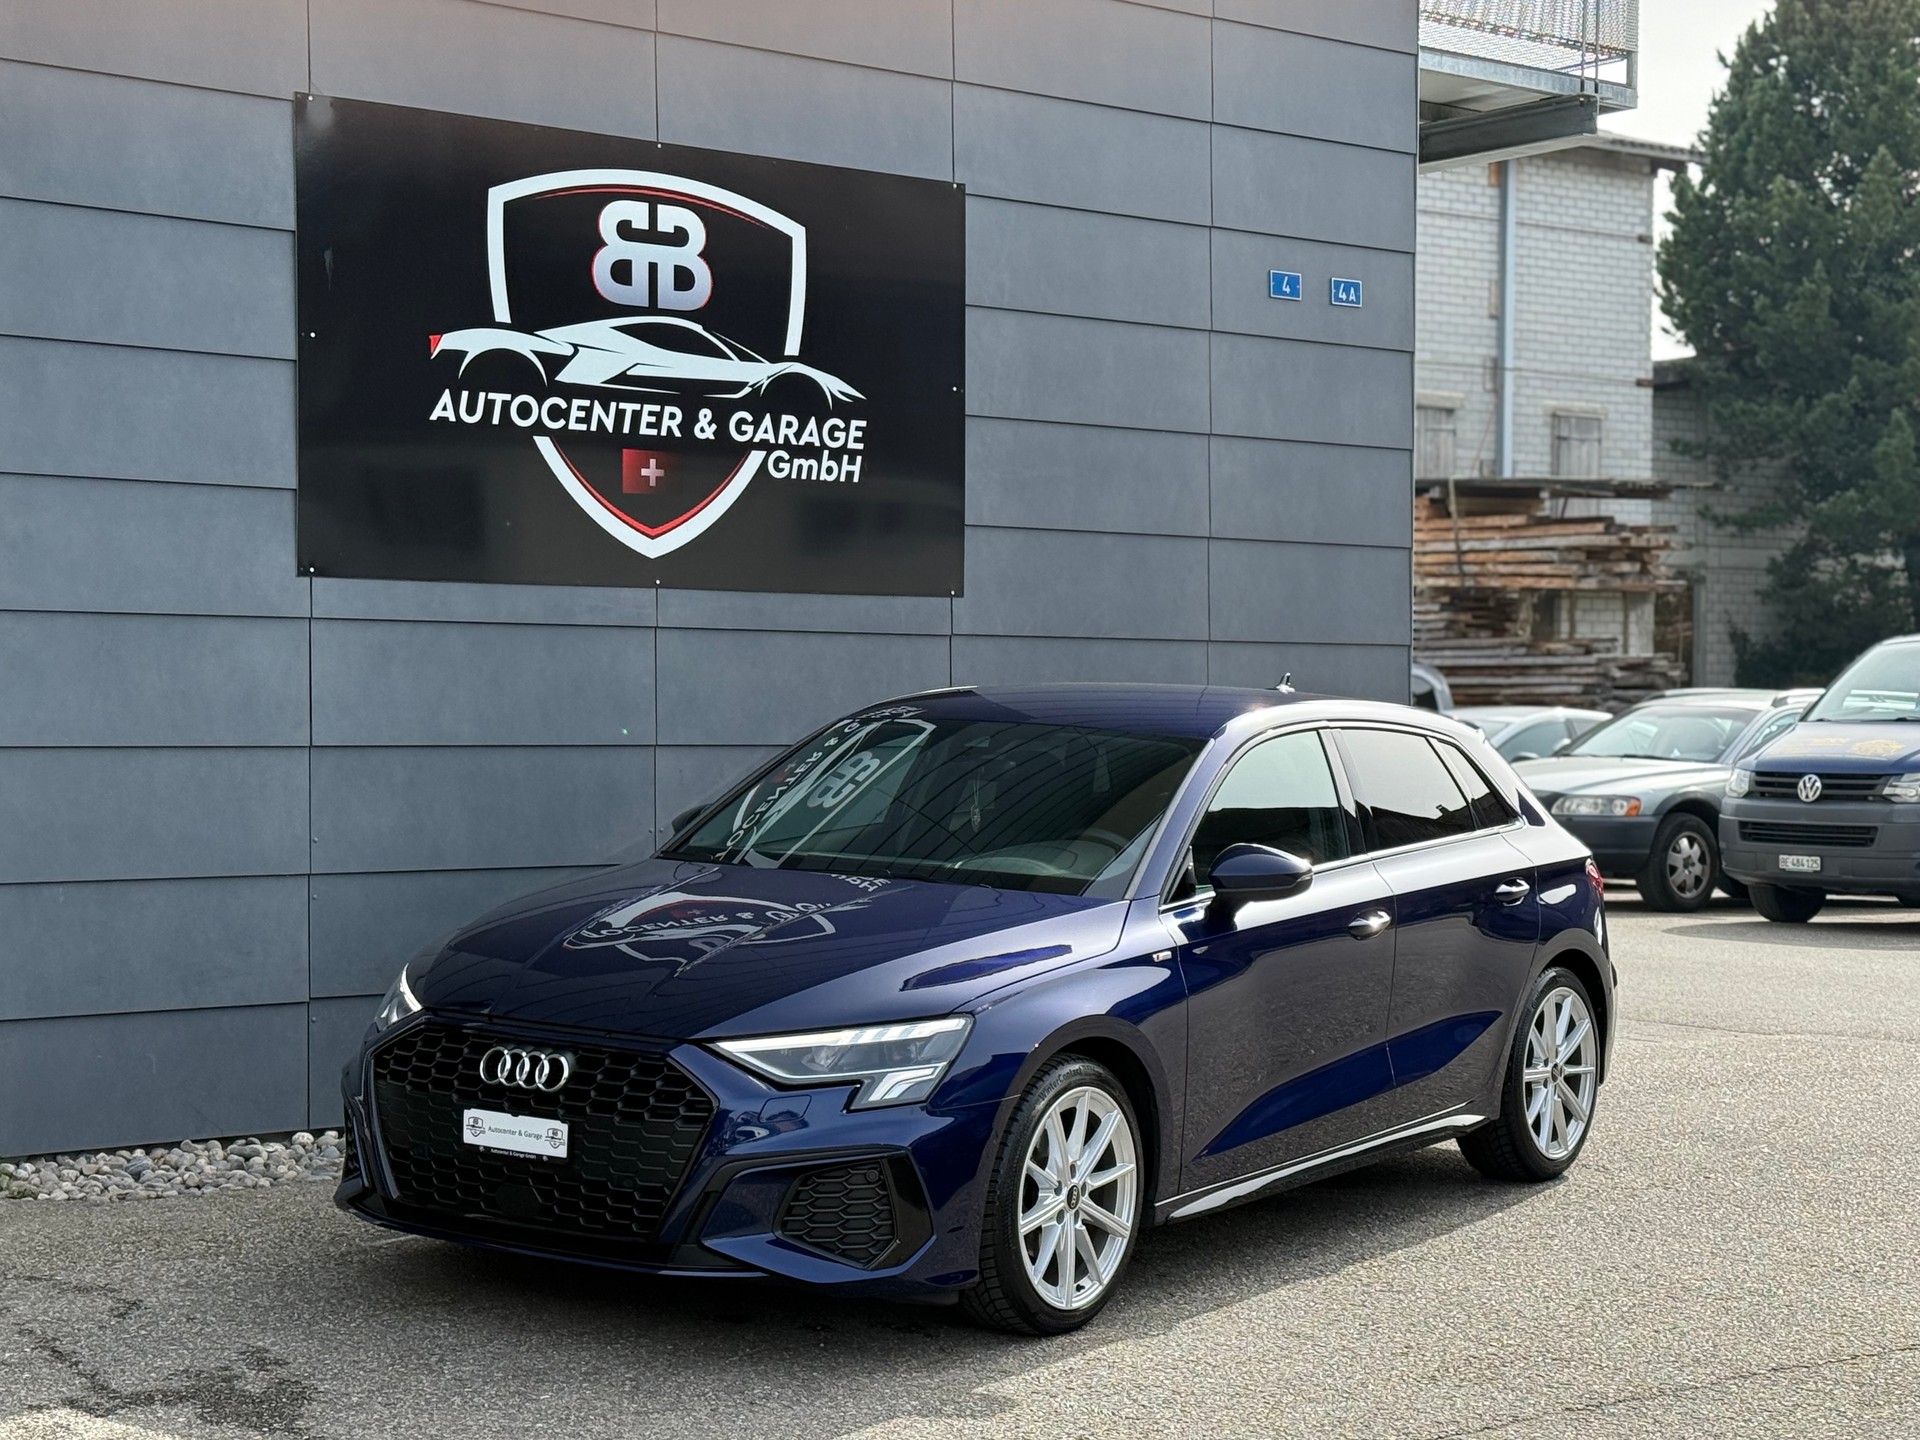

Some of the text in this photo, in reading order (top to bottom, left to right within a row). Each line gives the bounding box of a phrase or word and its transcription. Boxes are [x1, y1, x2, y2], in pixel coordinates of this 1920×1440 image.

[1282, 276, 1291, 294] 4
[1338, 283, 1356, 302] 4A
[429, 388, 867, 450] AUTOCENTER & GARAGE
[767, 450, 863, 483] GmbH
[488, 1126, 517, 1135] Autocenter
[524, 1131, 543, 1140] Garage
